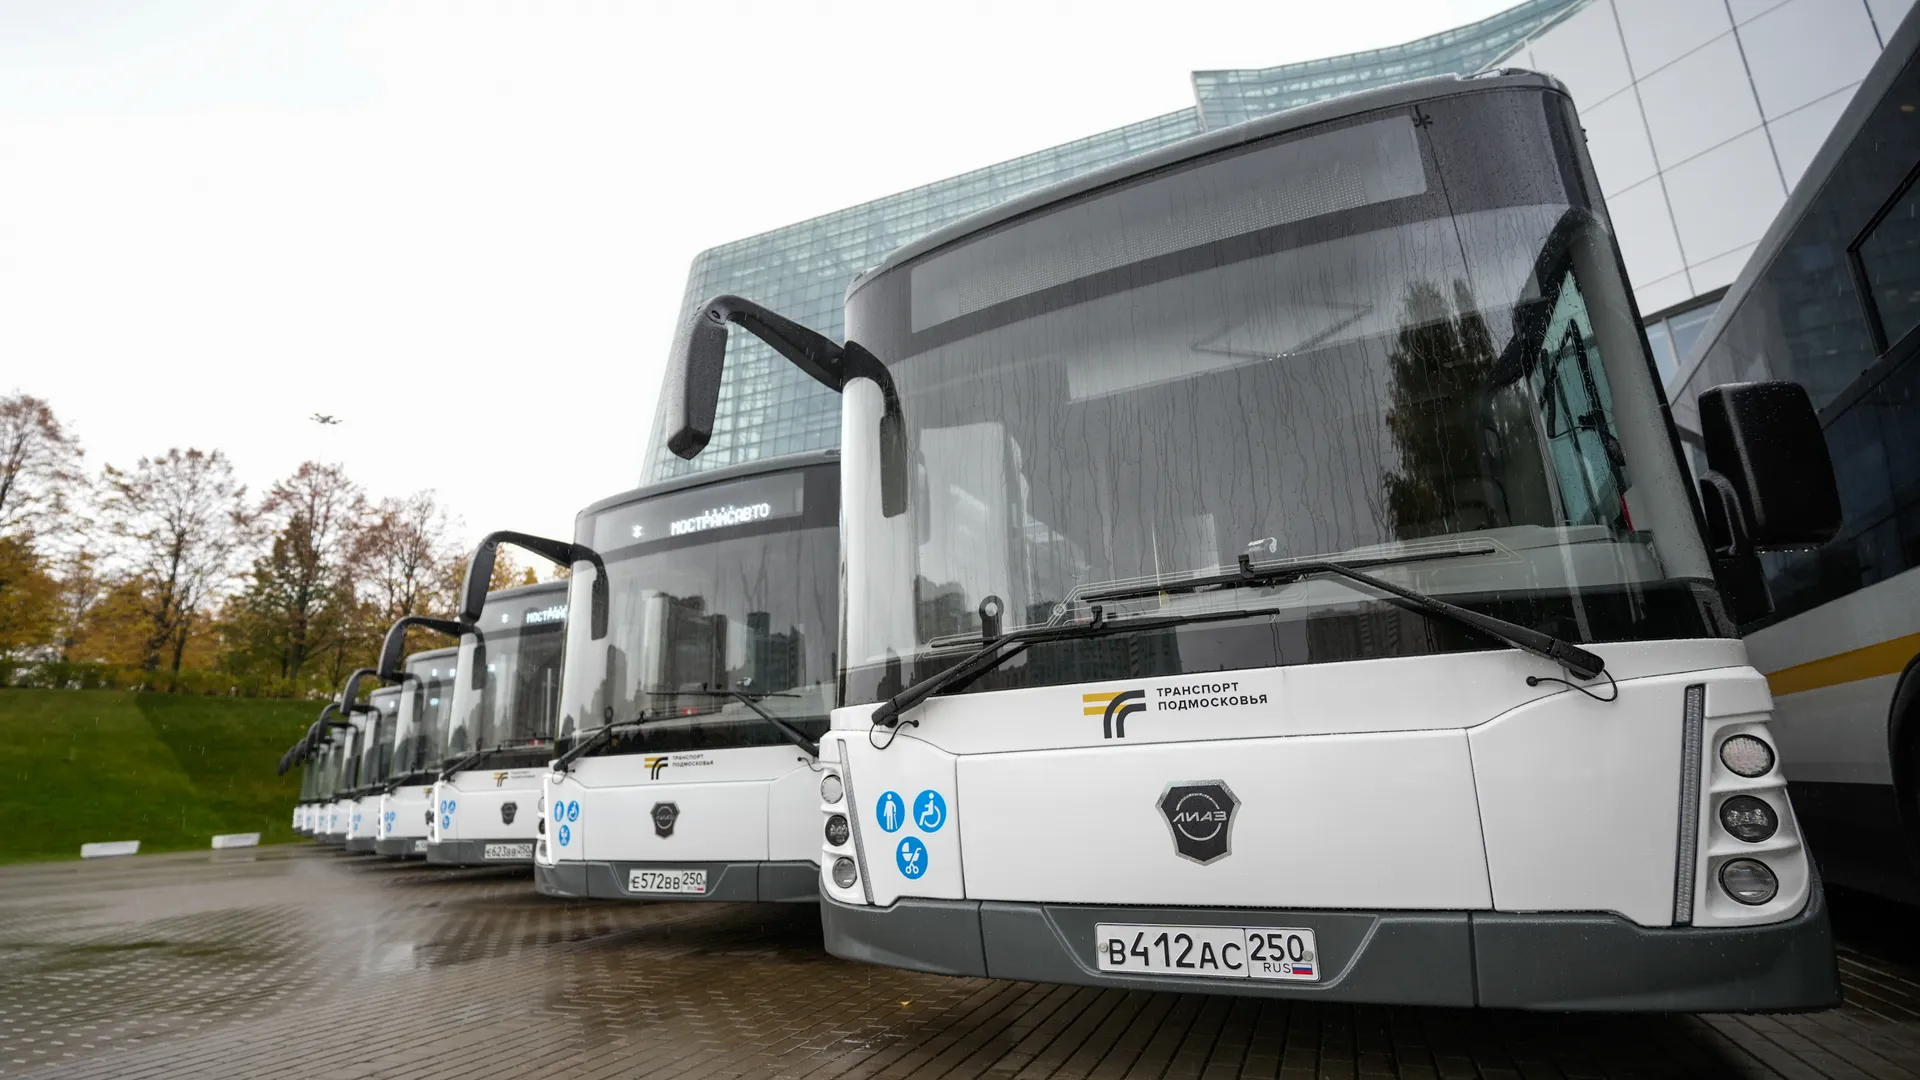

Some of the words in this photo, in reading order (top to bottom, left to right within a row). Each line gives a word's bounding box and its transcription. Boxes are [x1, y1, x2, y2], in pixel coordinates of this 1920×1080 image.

[1156, 682, 1239, 697] ТРАНСПОРТ
[1158, 694, 1268, 711] ПОДМОСКОВЬЯ
[1172, 810, 1228, 823] ЛИАЗ
[632, 872, 681, 890] Е572ВВ
[683, 872, 703, 885] 250
[1108, 931, 1243, 970] В412АС
[1248, 933, 1305, 962] 250
[1263, 962, 1292, 974] RUS
